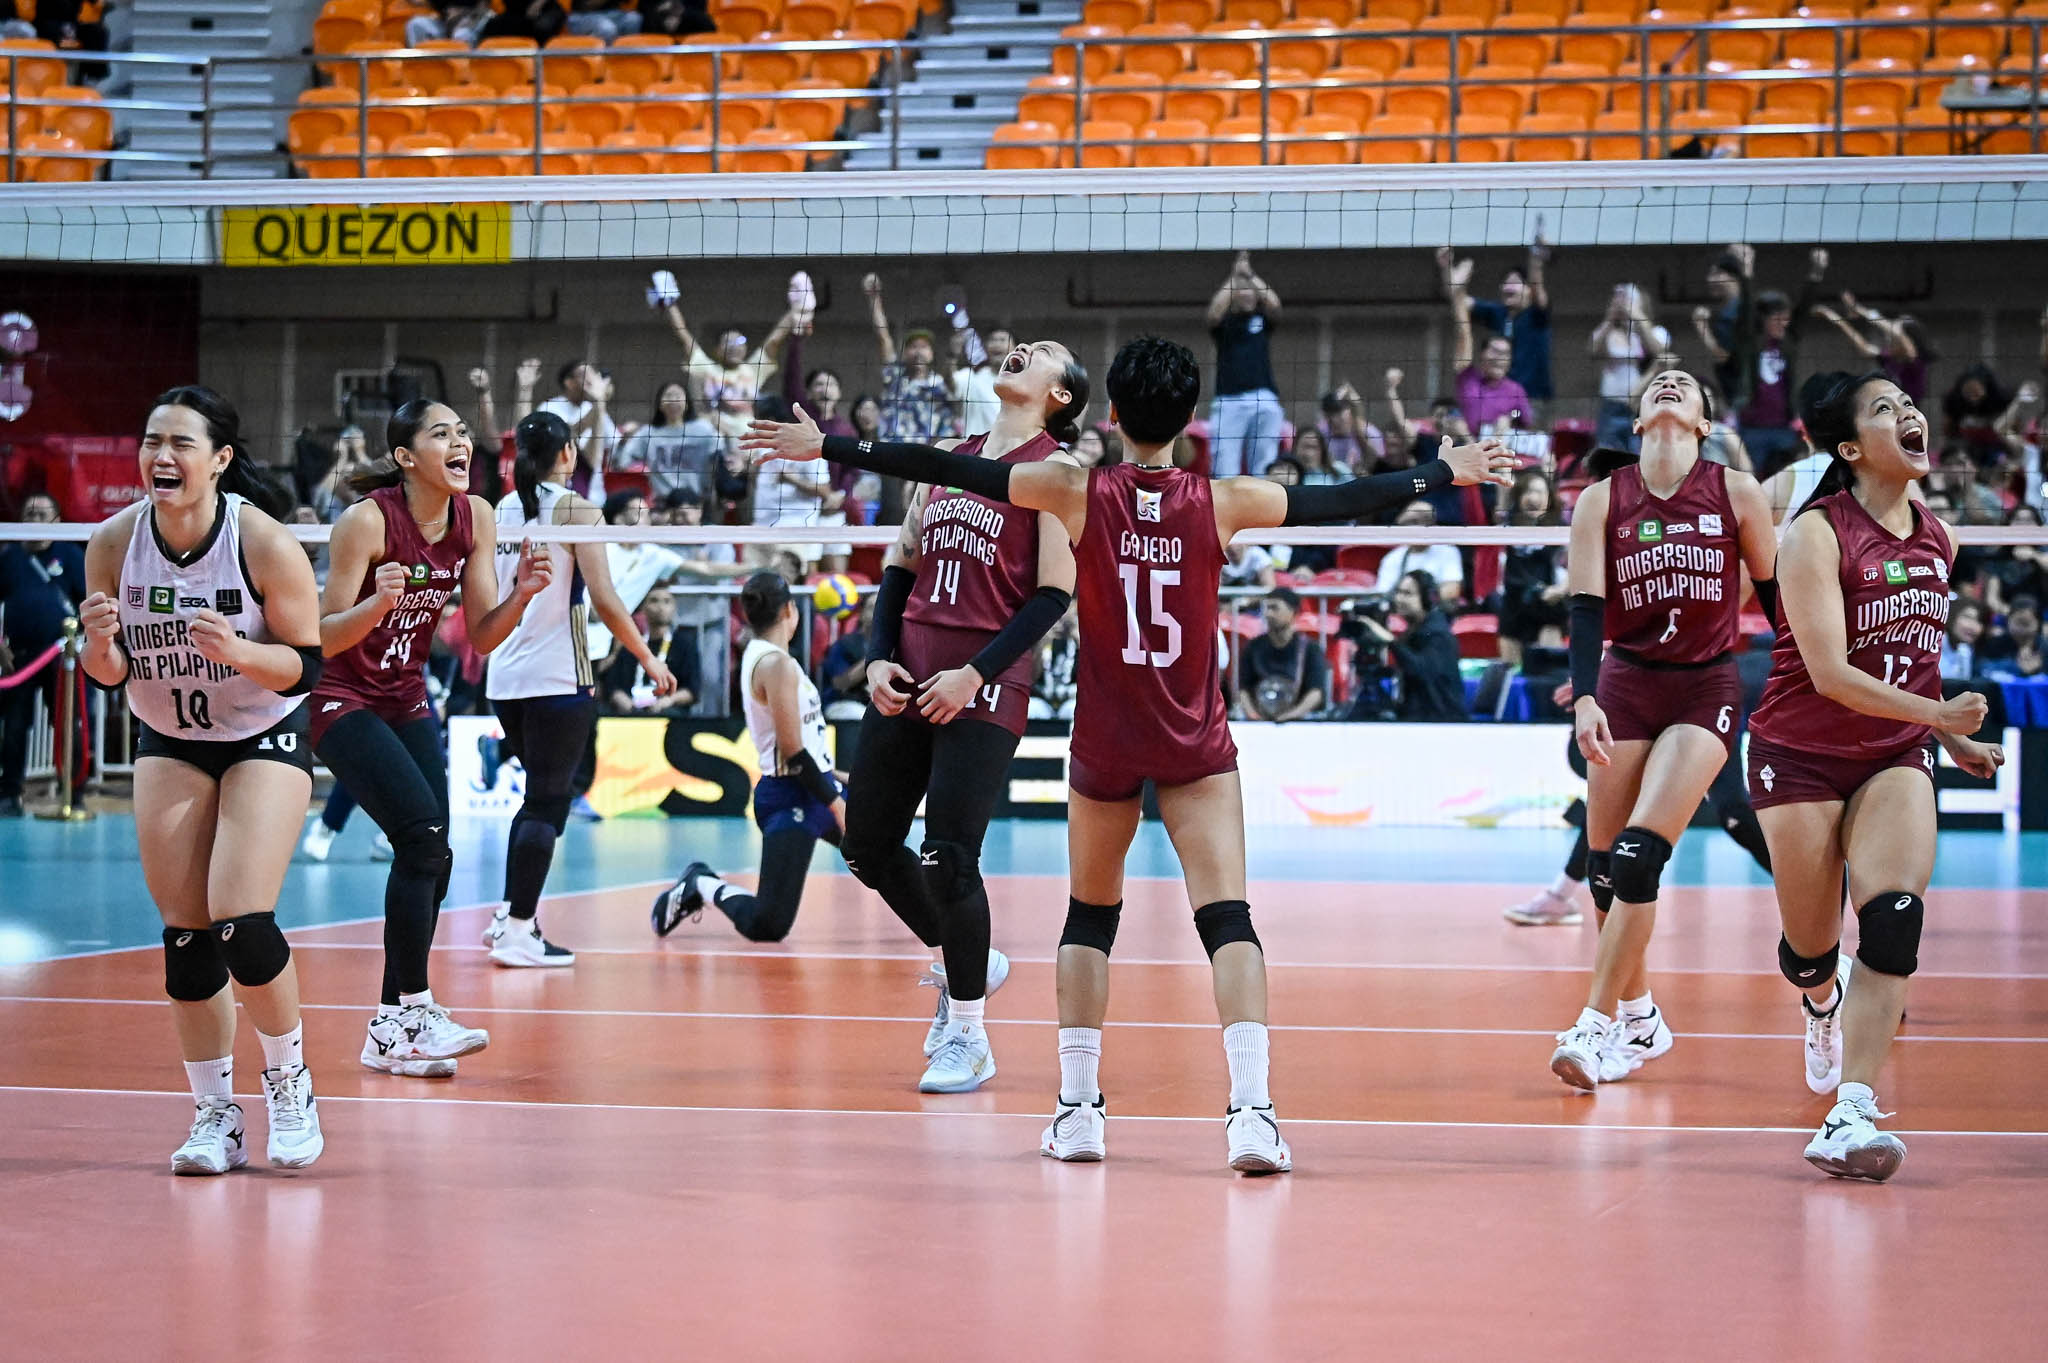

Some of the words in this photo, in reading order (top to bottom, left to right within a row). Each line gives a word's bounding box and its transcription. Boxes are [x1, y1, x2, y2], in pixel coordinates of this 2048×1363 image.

[254, 211, 479, 263] QUEZON
[932, 524, 997, 567] PILIPINAS
[1120, 529, 1183, 564] GAJERO
[1616, 543, 1725, 584] UNIBERSIDAD
[929, 559, 961, 605] 14
[1621, 583, 1643, 612] NG
[1645, 572, 1722, 604] PILIPINAS
[1118, 563, 1182, 668] 15
[1659, 608, 1682, 644] 6
[1857, 587, 1950, 632] UNIBERSIDA
[380, 632, 417, 670] 24
[171, 688, 214, 731] 10
[1716, 704, 1735, 734] 6
